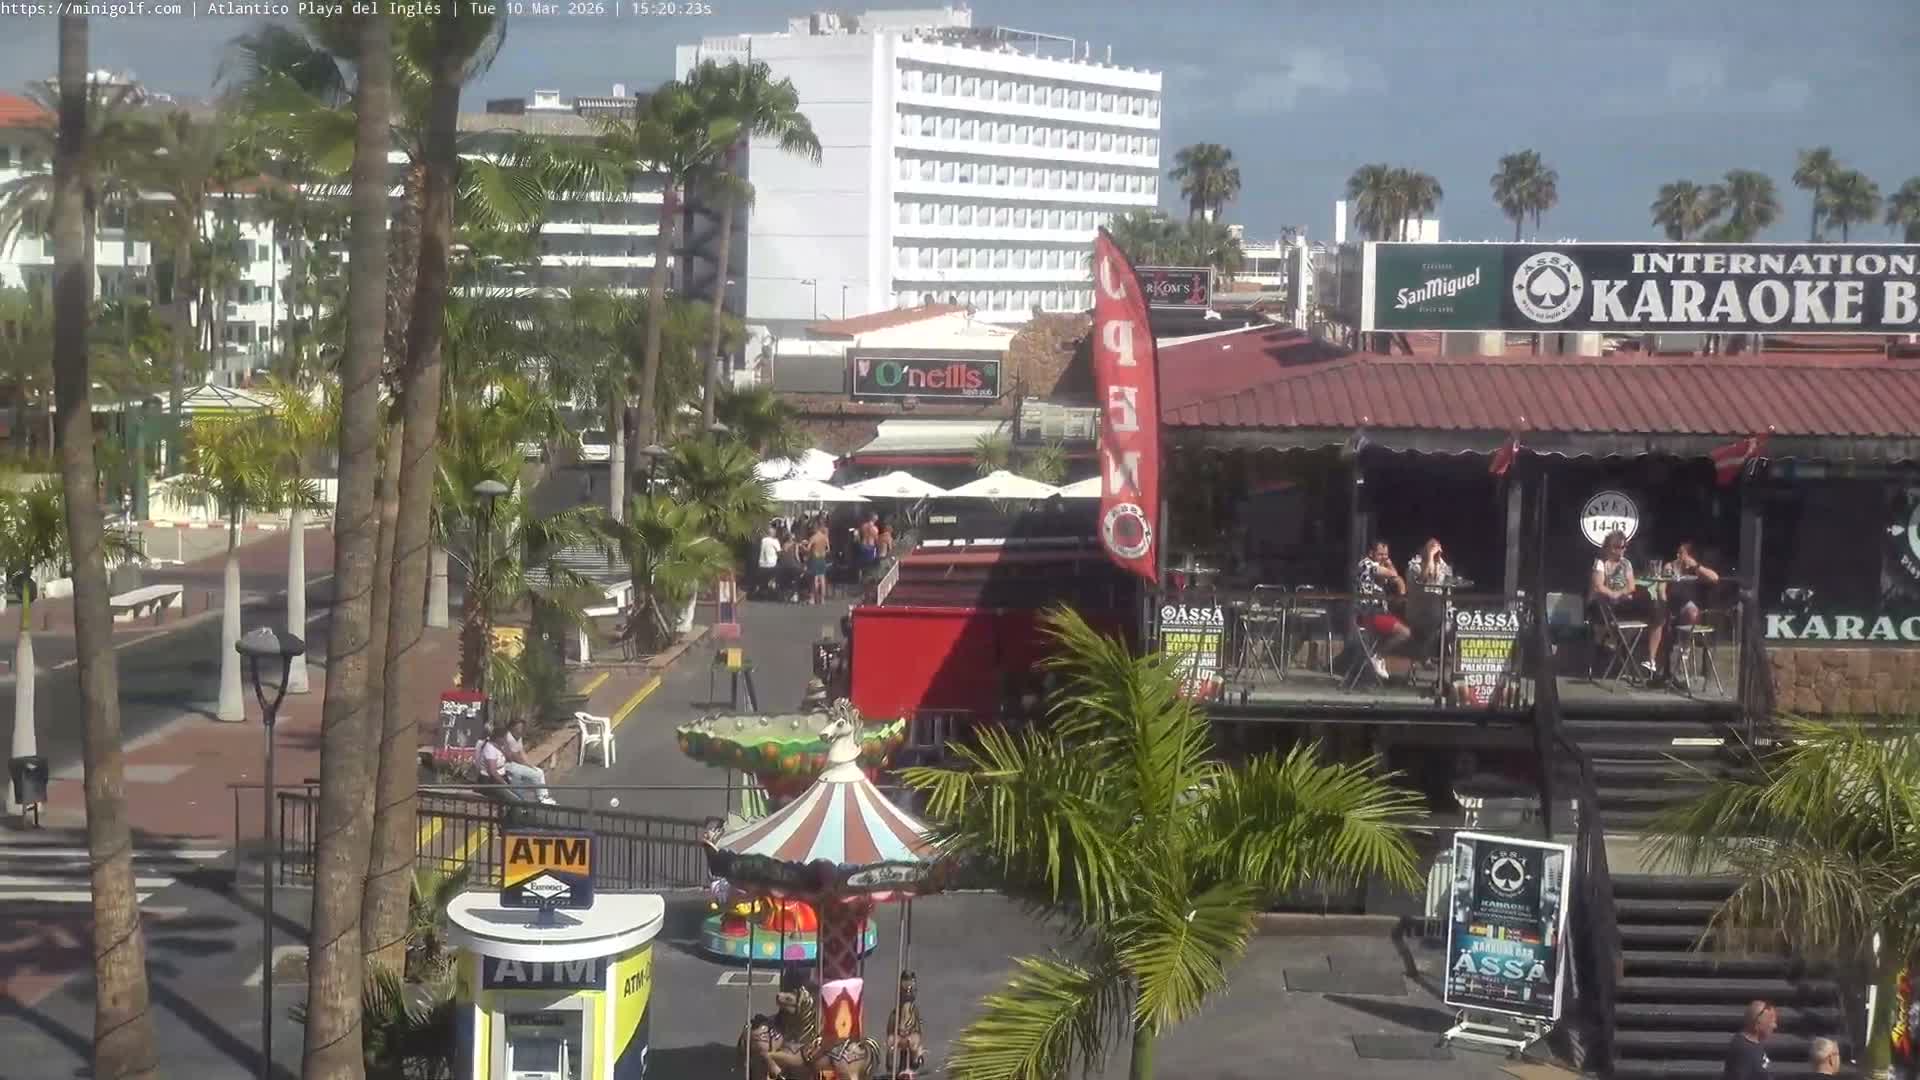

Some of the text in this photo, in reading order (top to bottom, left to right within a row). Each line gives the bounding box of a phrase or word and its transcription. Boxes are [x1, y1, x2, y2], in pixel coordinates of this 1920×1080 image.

[1631, 253, 1920, 275] INTERNATION
[1590, 279, 1920, 324] KARAOKE B
[1593, 519, 1626, 532] 14-03
[1175, 604, 1224, 621] ÄSSÄ
[1472, 610, 1519, 627] ÄSSÄ
[510, 838, 586, 866] ATM
[493, 959, 597, 983] ATM
[1453, 949, 1549, 984] ÄSSÄ
